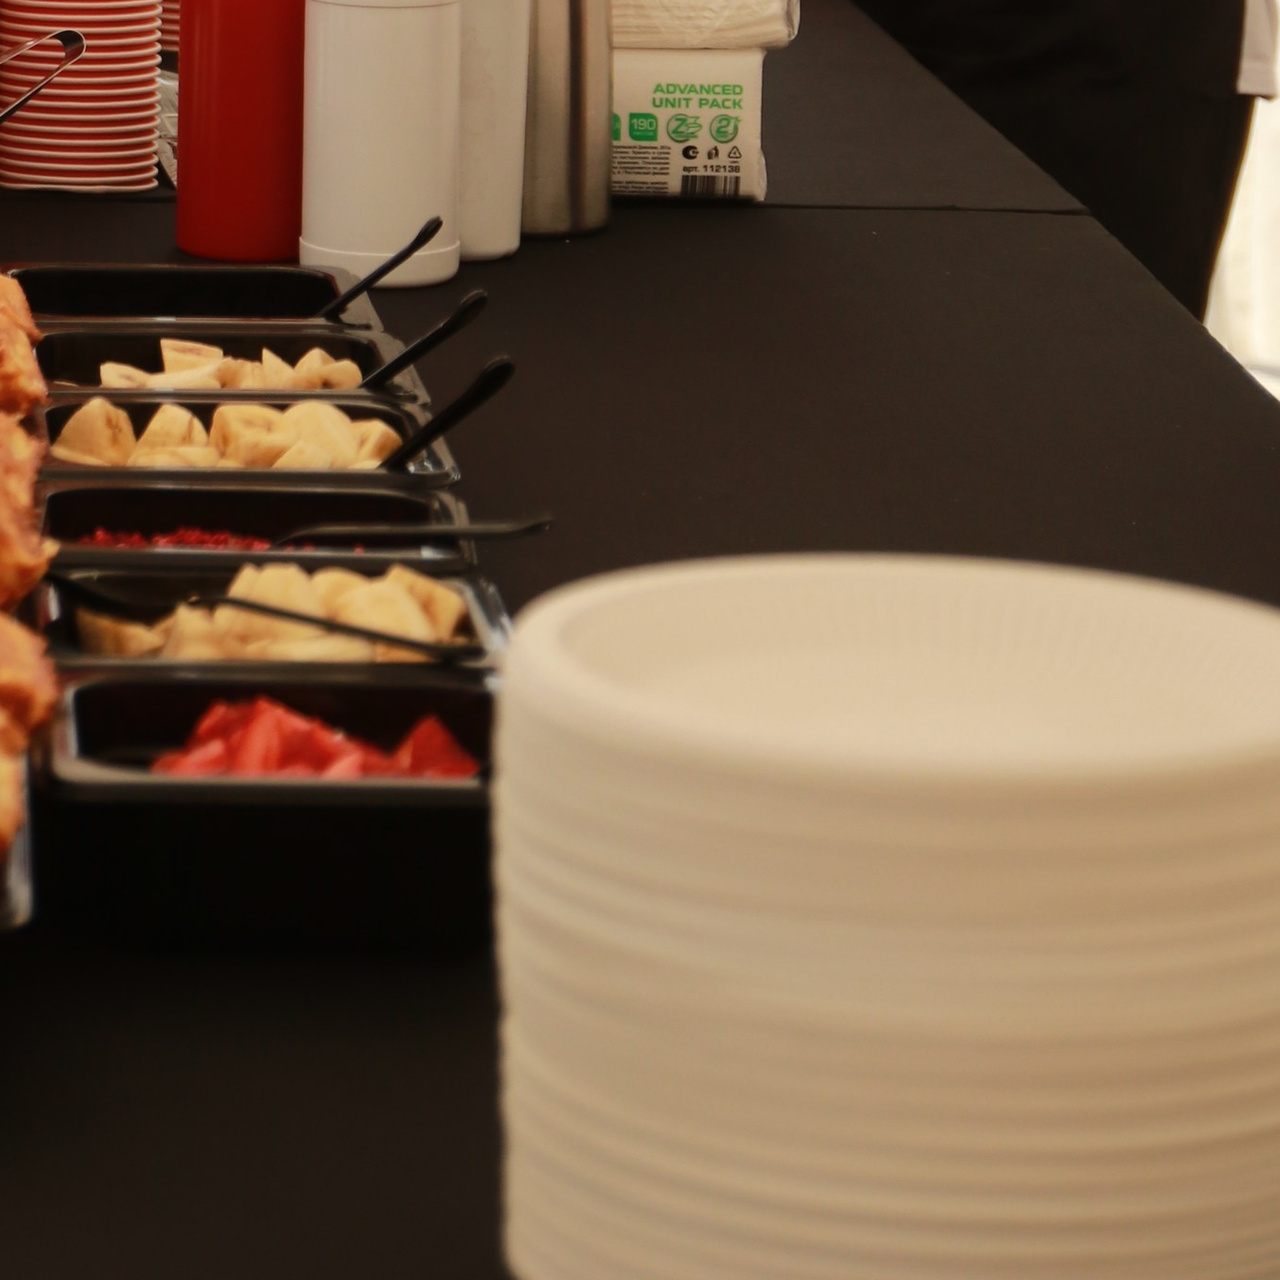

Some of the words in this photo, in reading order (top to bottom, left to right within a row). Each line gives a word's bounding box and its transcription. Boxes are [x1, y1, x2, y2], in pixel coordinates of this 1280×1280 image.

[653, 83, 743, 95] ADVANCED
[652, 97, 692, 109] UNIT
[699, 98, 743, 109] PACK
[632, 118, 656, 130] 190
[703, 165, 740, 173] 112138
